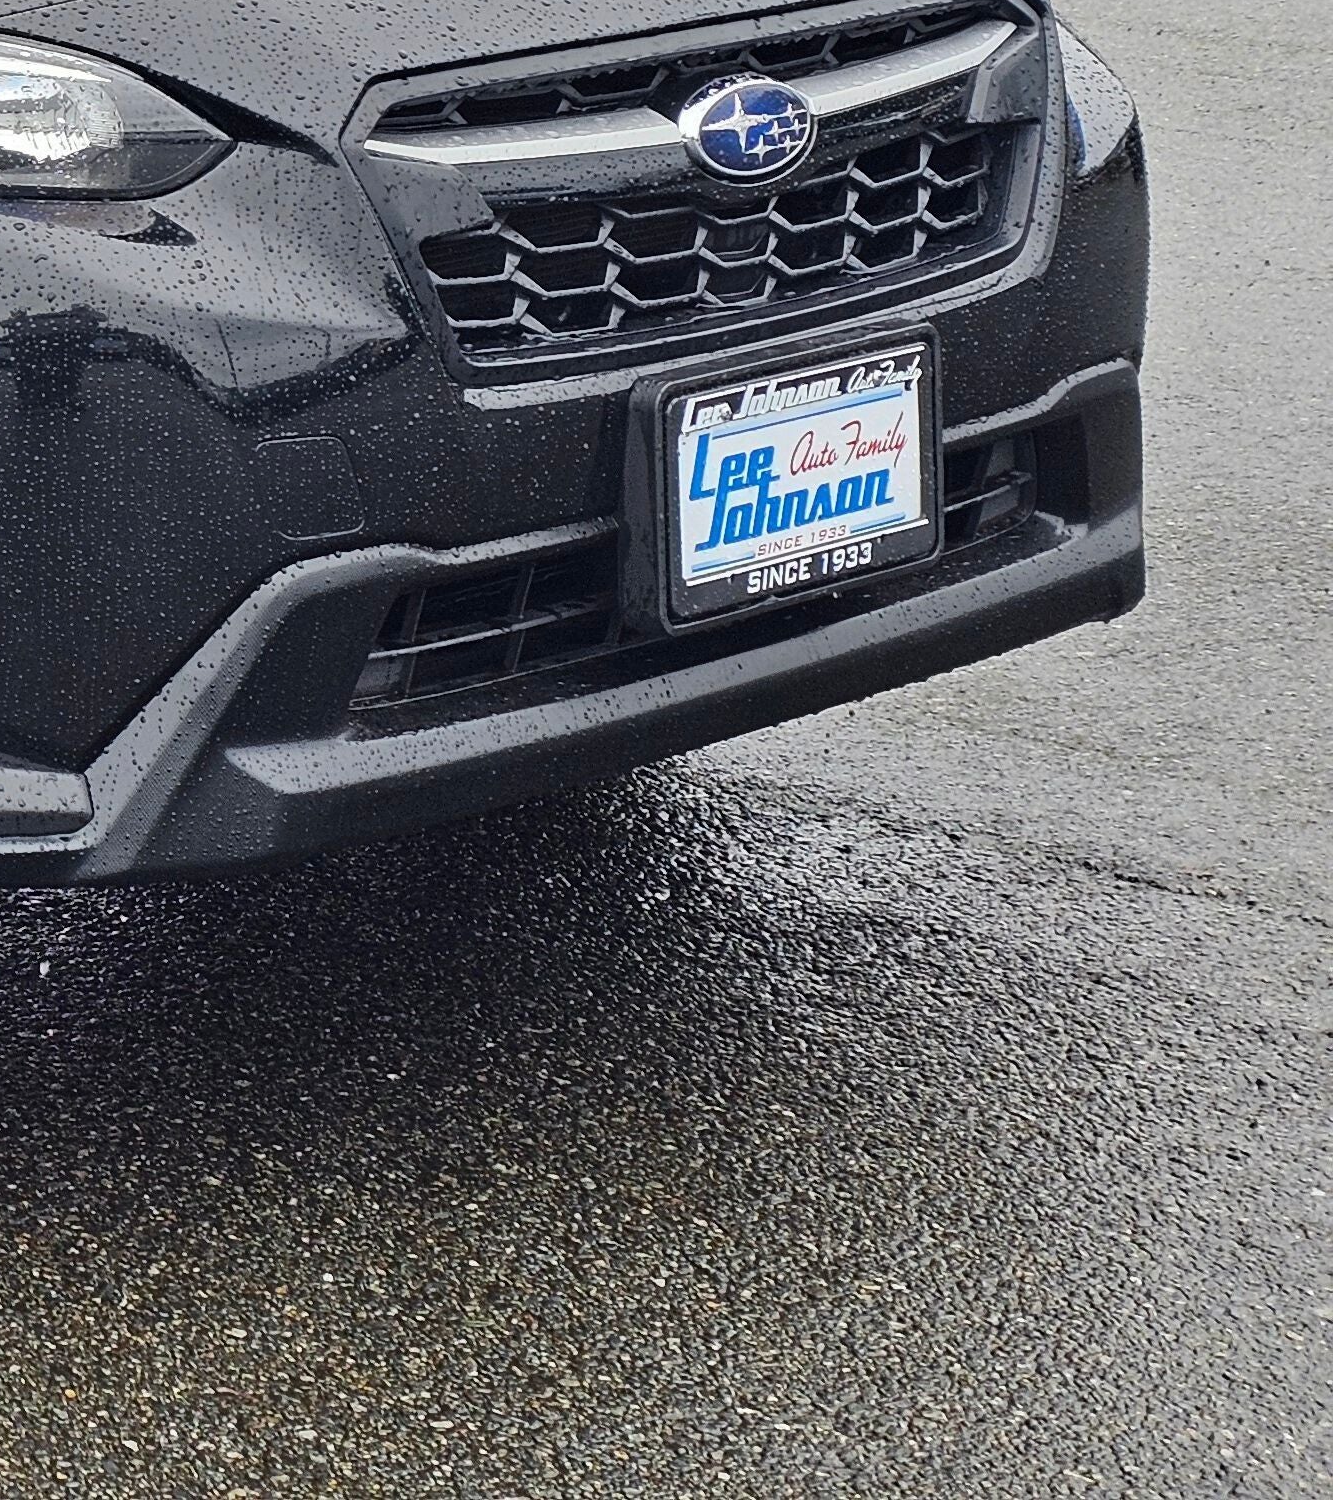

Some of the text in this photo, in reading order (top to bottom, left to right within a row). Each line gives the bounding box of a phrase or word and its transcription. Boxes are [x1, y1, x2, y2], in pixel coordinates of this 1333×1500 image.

[682, 354, 923, 436] Lee Johnson Auto Family
[688, 433, 780, 502] Lee
[790, 410, 908, 477] Auto Family
[694, 466, 895, 553] Johnson
[756, 524, 847, 558] SINCE 1933
[746, 541, 873, 595] SINCE 1933
